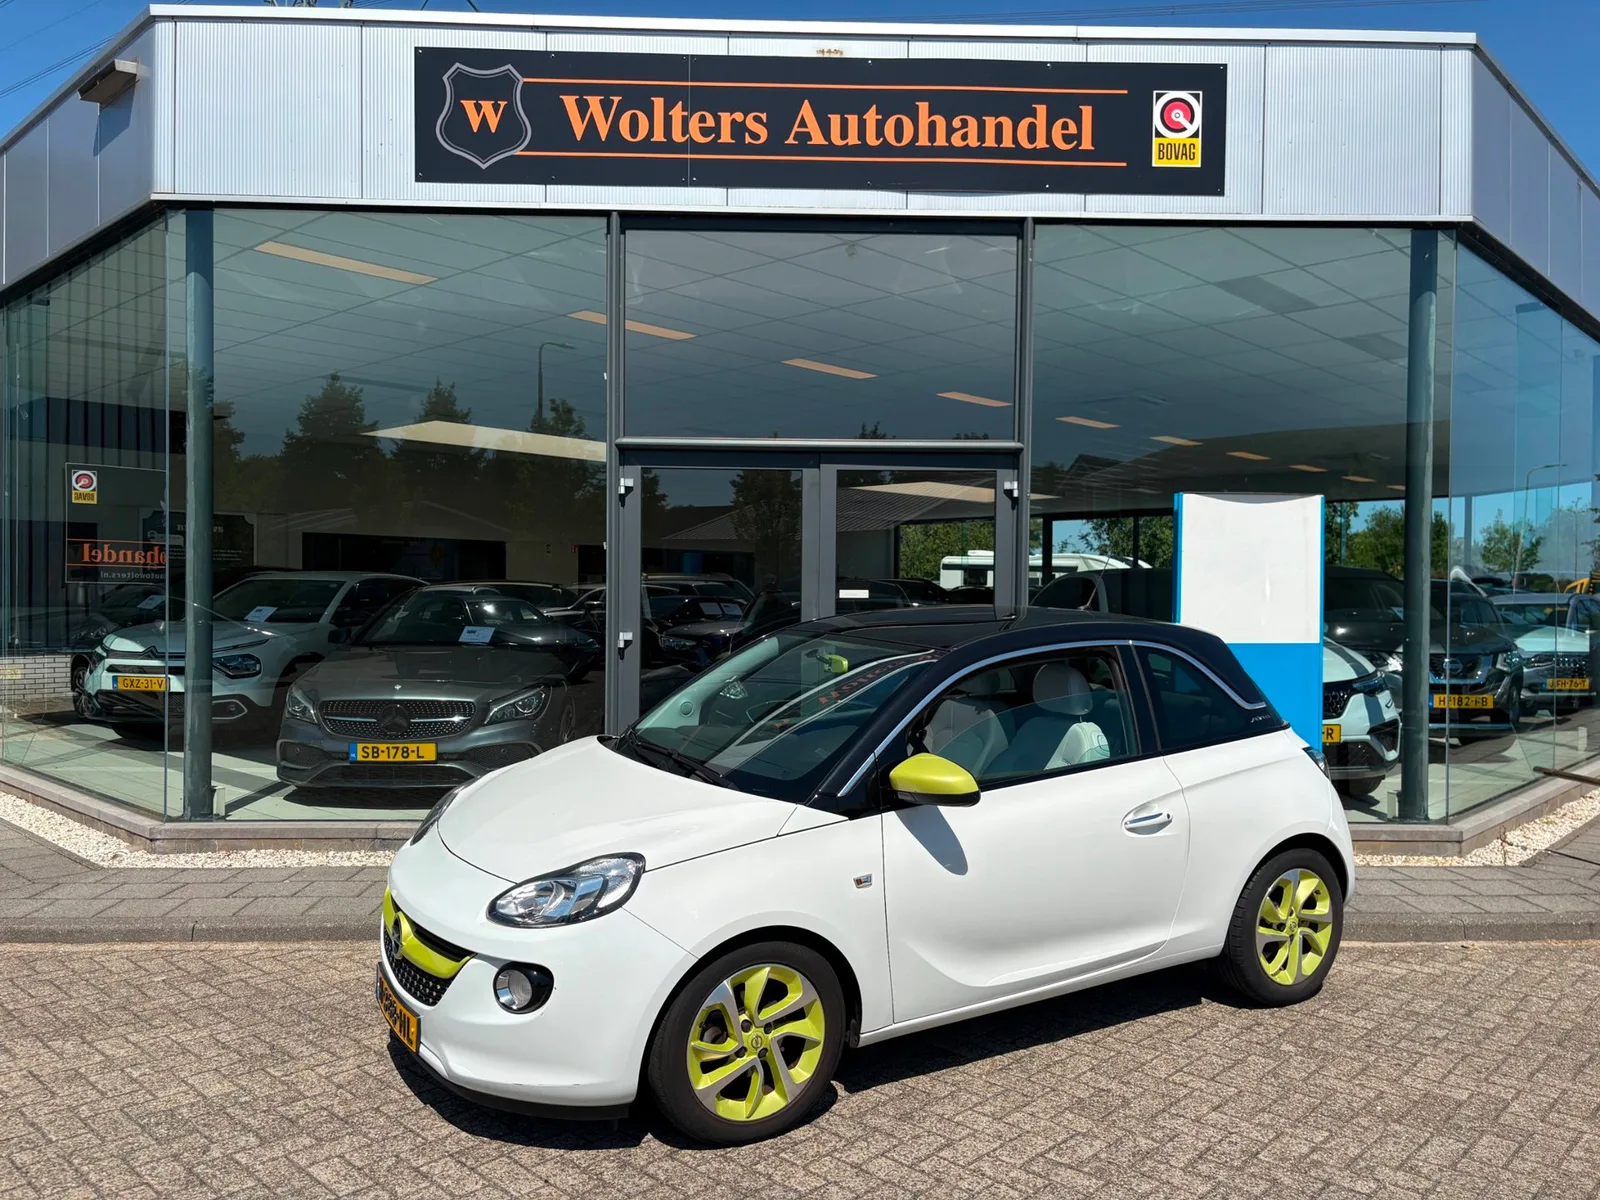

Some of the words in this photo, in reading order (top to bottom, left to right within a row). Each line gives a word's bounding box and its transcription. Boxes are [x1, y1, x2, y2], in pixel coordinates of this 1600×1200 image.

[460, 99, 508, 134] W
[559, 95, 768, 145] Wolters
[785, 98, 1096, 151] Autohandel
[1158, 142, 1196, 161] BOVAG
[122, 678, 164, 689] GXZ-31-V
[361, 745, 425, 760] SB-178-L
